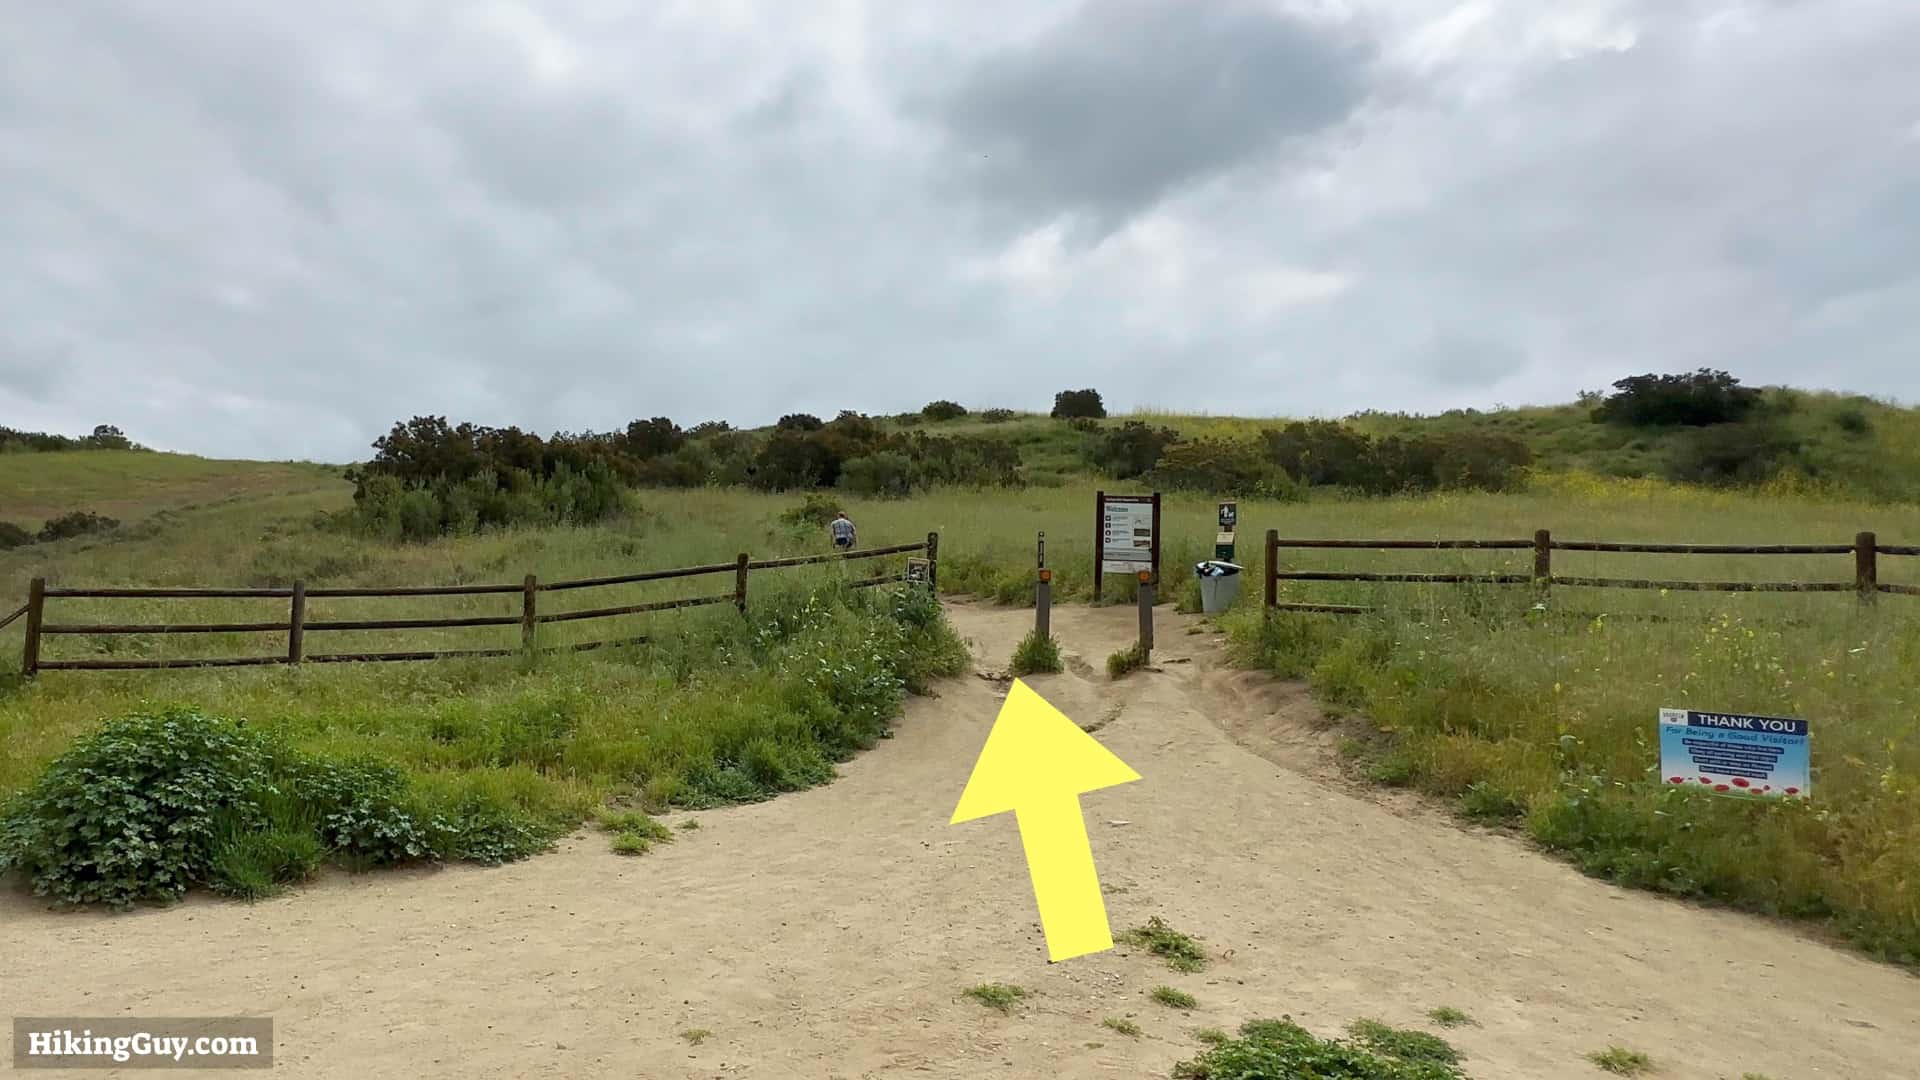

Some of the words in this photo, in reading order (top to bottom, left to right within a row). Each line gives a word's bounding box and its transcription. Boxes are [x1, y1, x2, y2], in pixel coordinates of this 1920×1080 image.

[1697, 714, 1754, 730] THANK
[1758, 719, 1797, 733] YOU
[1665, 726, 1682, 735] For
[1686, 727, 1714, 740] Being
[1727, 731, 1759, 742] Good
